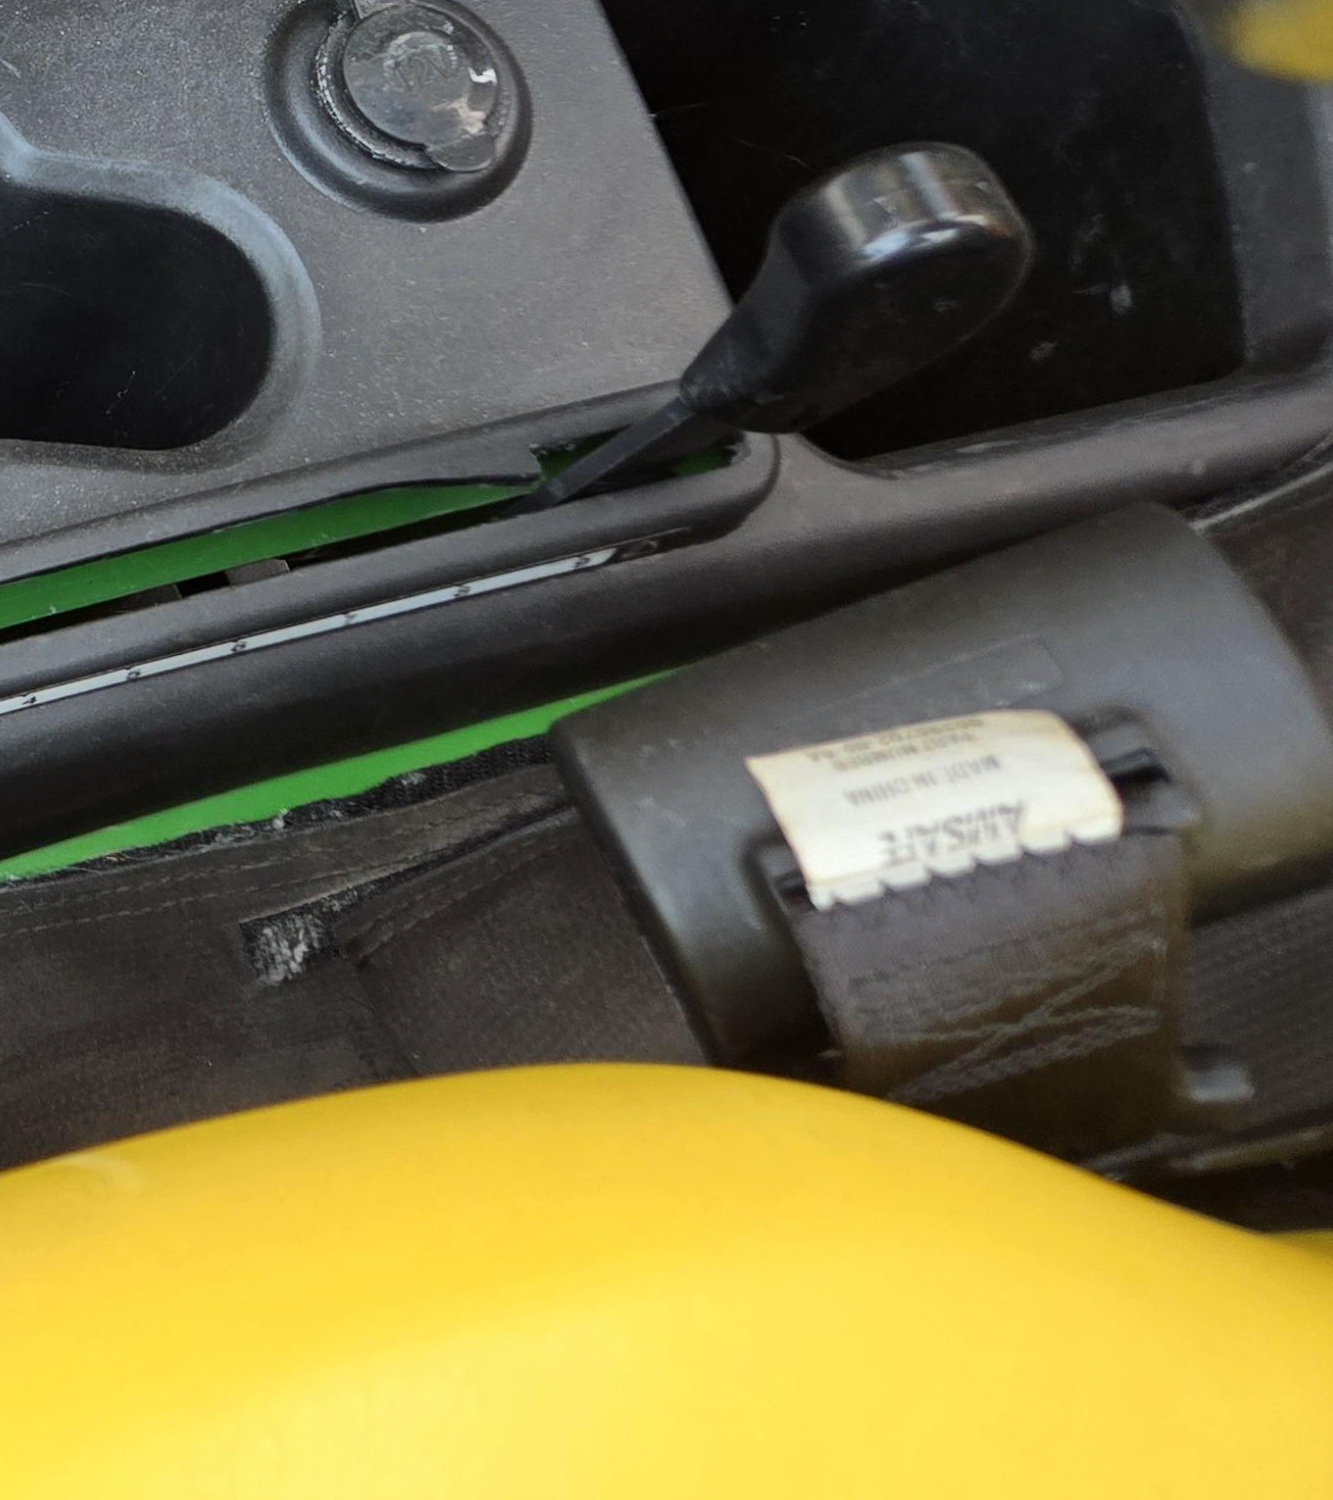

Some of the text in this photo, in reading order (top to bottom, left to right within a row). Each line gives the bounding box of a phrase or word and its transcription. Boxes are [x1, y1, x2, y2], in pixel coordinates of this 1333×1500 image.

[22, 695, 36, 706] 4
[843, 754, 1001, 807] MADE IN CHINA
